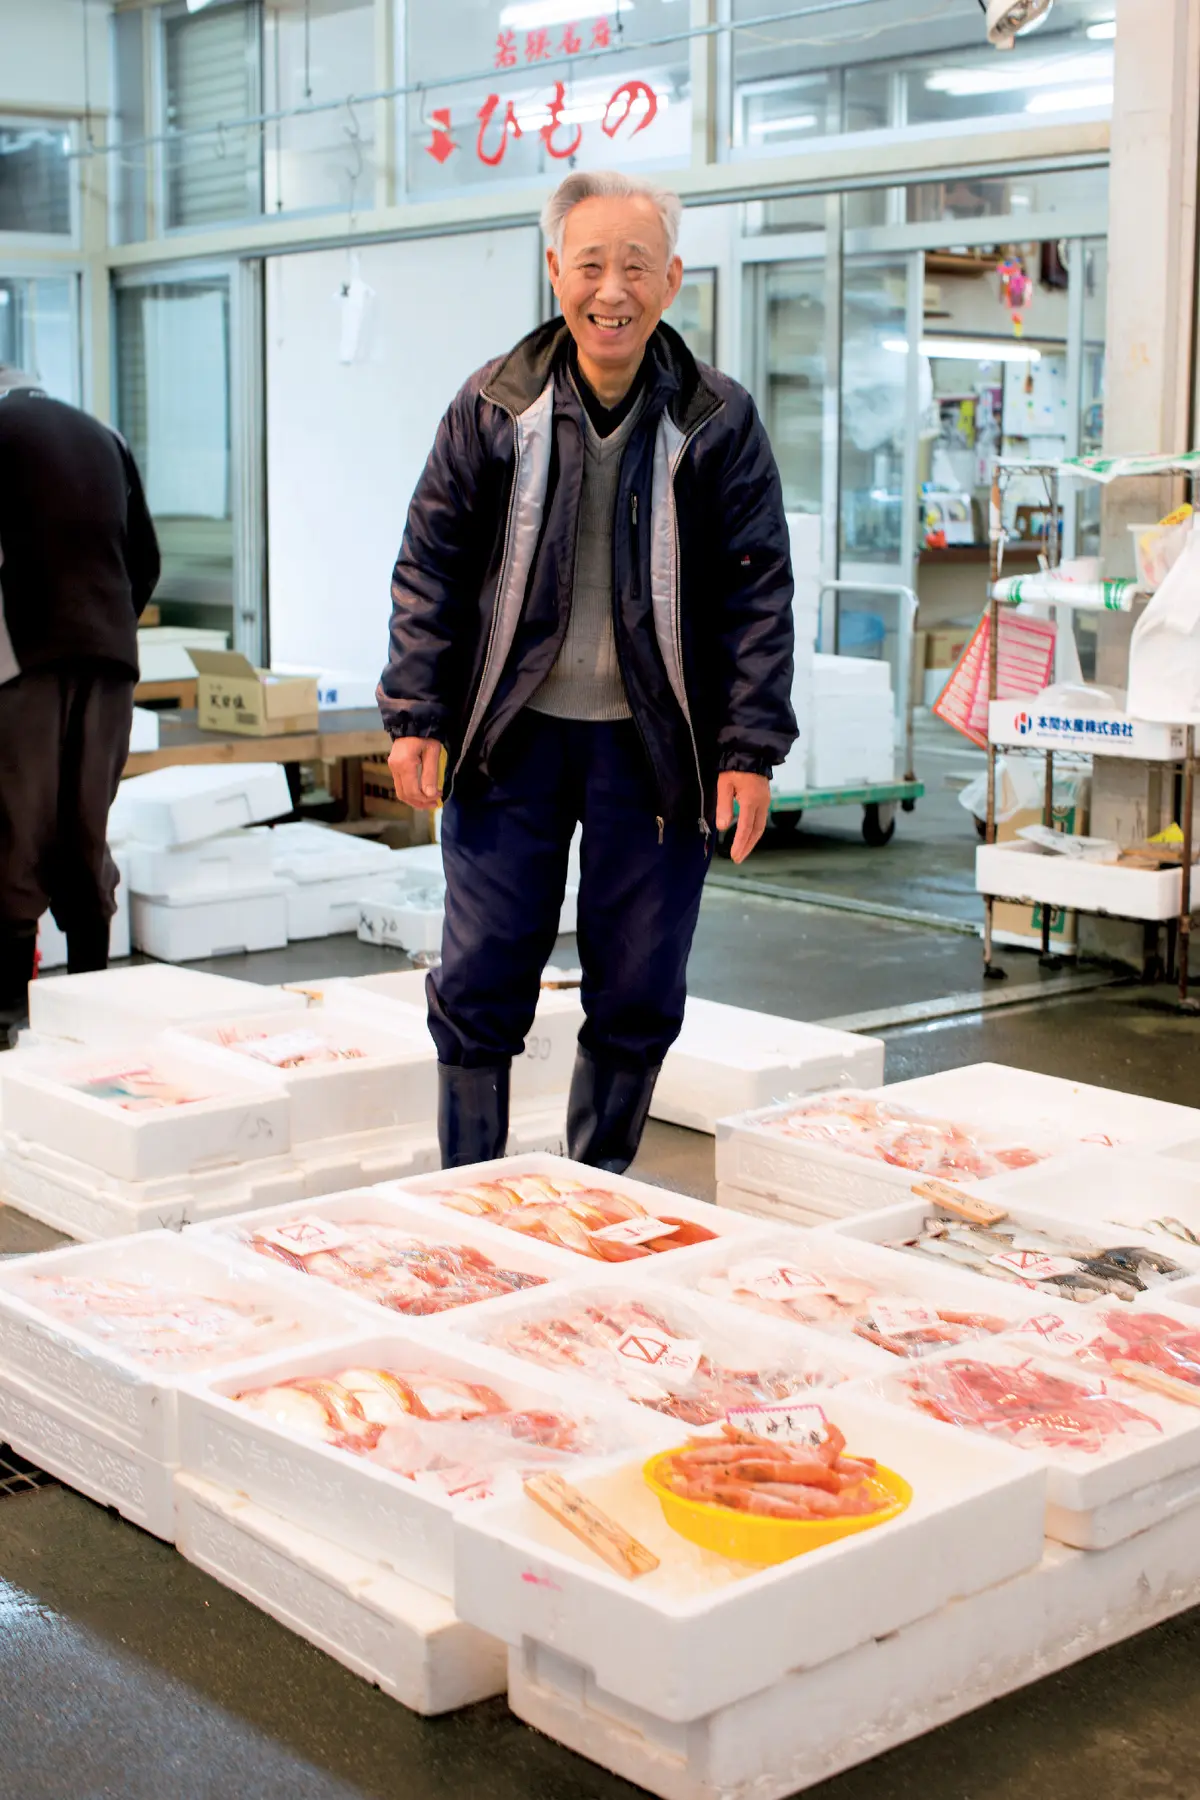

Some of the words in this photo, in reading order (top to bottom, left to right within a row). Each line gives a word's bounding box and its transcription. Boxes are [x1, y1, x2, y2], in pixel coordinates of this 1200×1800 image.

[476, 81, 657, 166] ひもの
[1037, 715, 1133, 736] 本間水産株式会社
